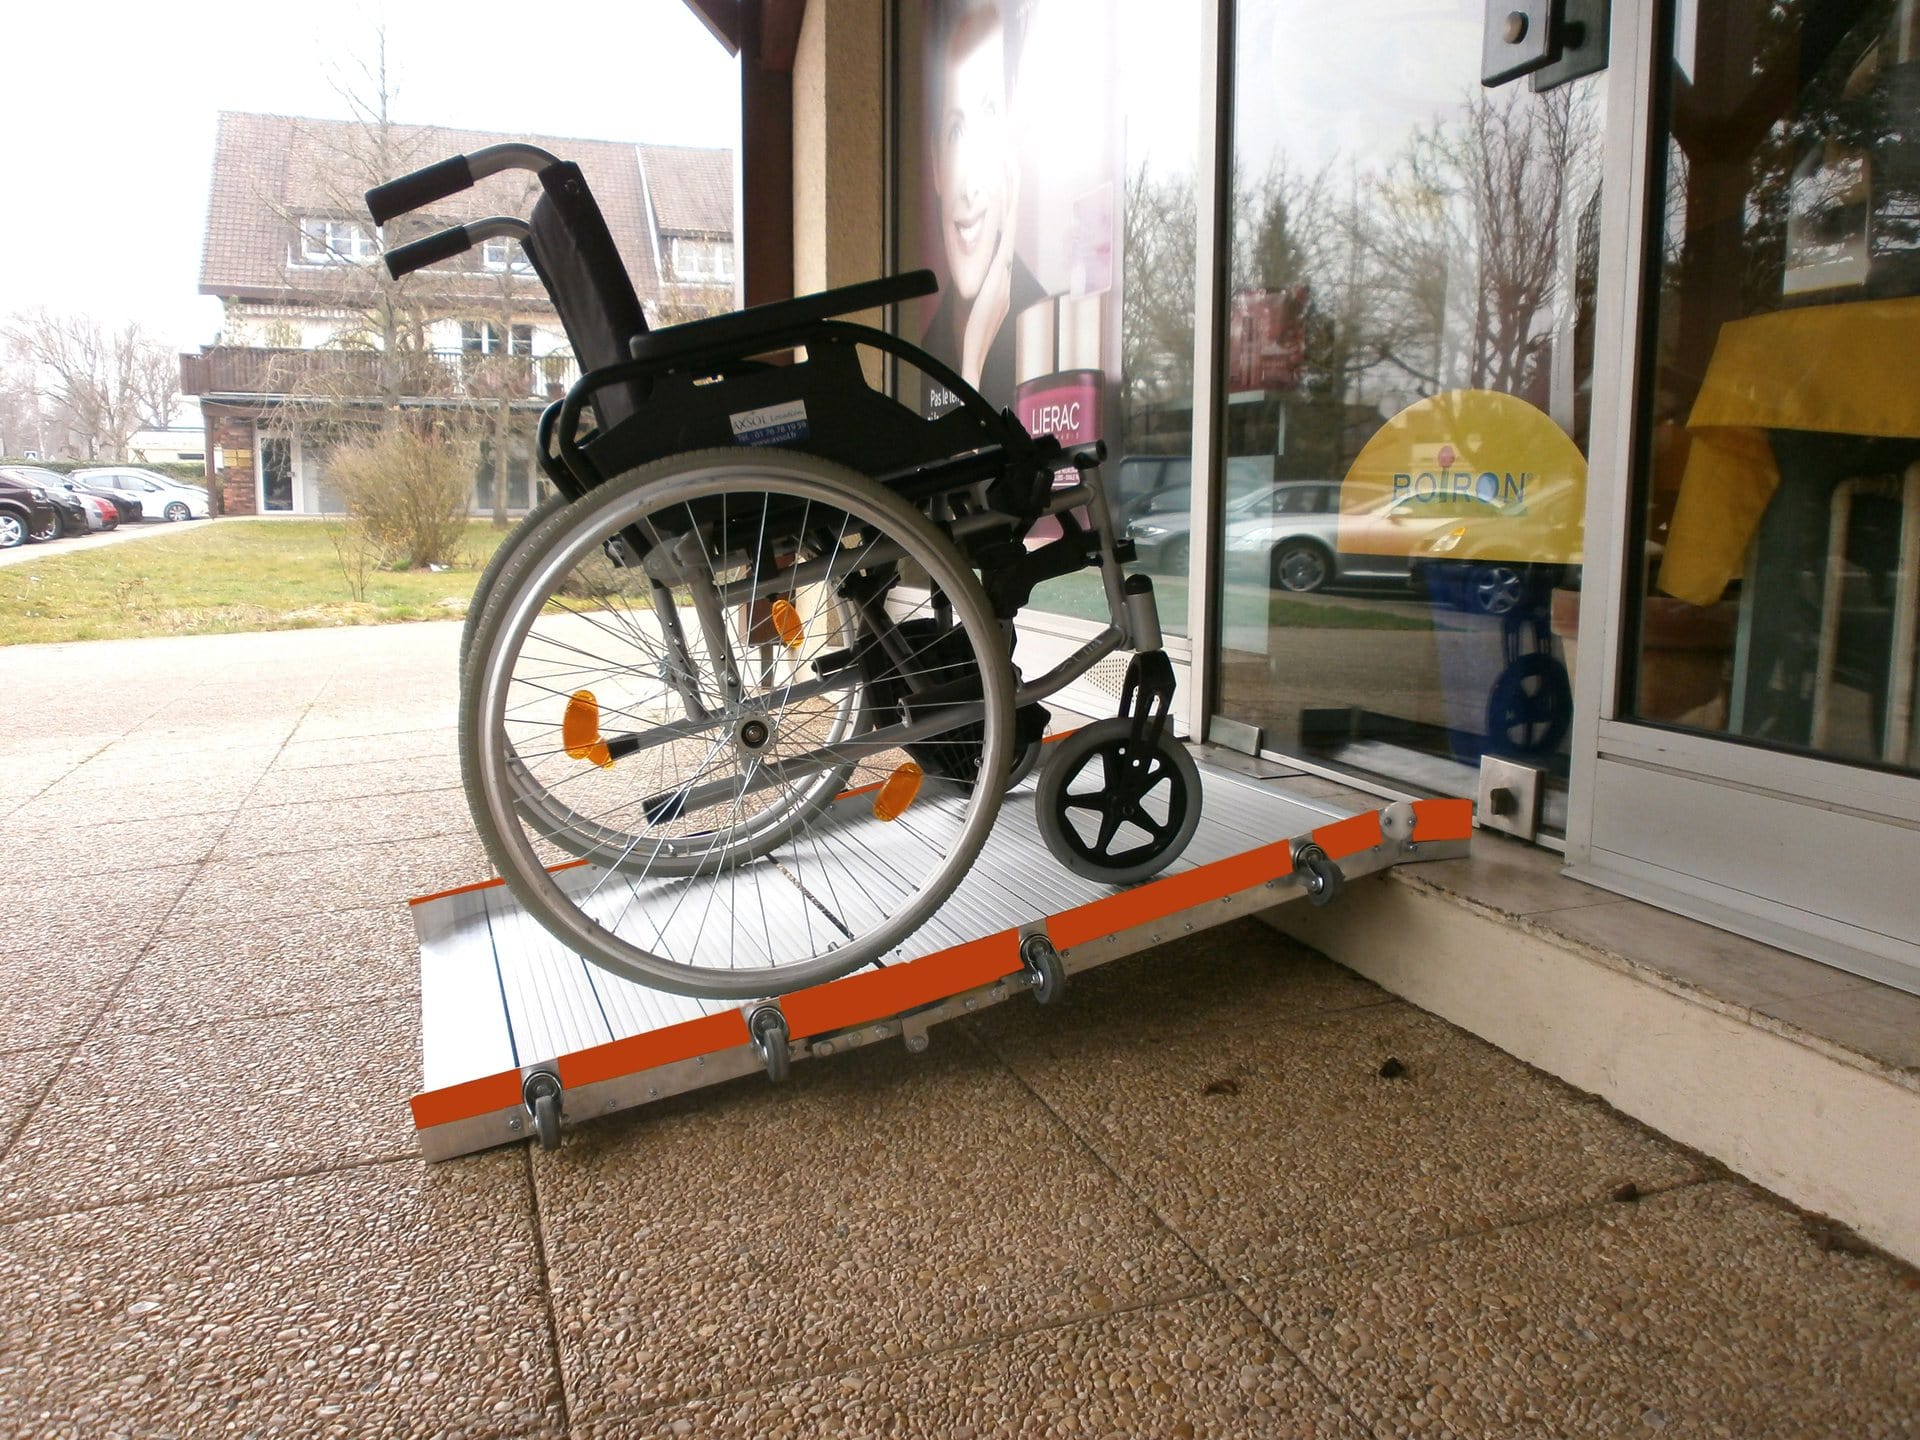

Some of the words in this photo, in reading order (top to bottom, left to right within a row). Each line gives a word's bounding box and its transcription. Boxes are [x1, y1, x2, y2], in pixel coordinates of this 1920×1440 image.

[930, 389, 942, 407] Pas
[942, 387, 949, 405] le
[1032, 401, 1080, 434] LIERAC
[1393, 468, 1526, 505] BOIRON
